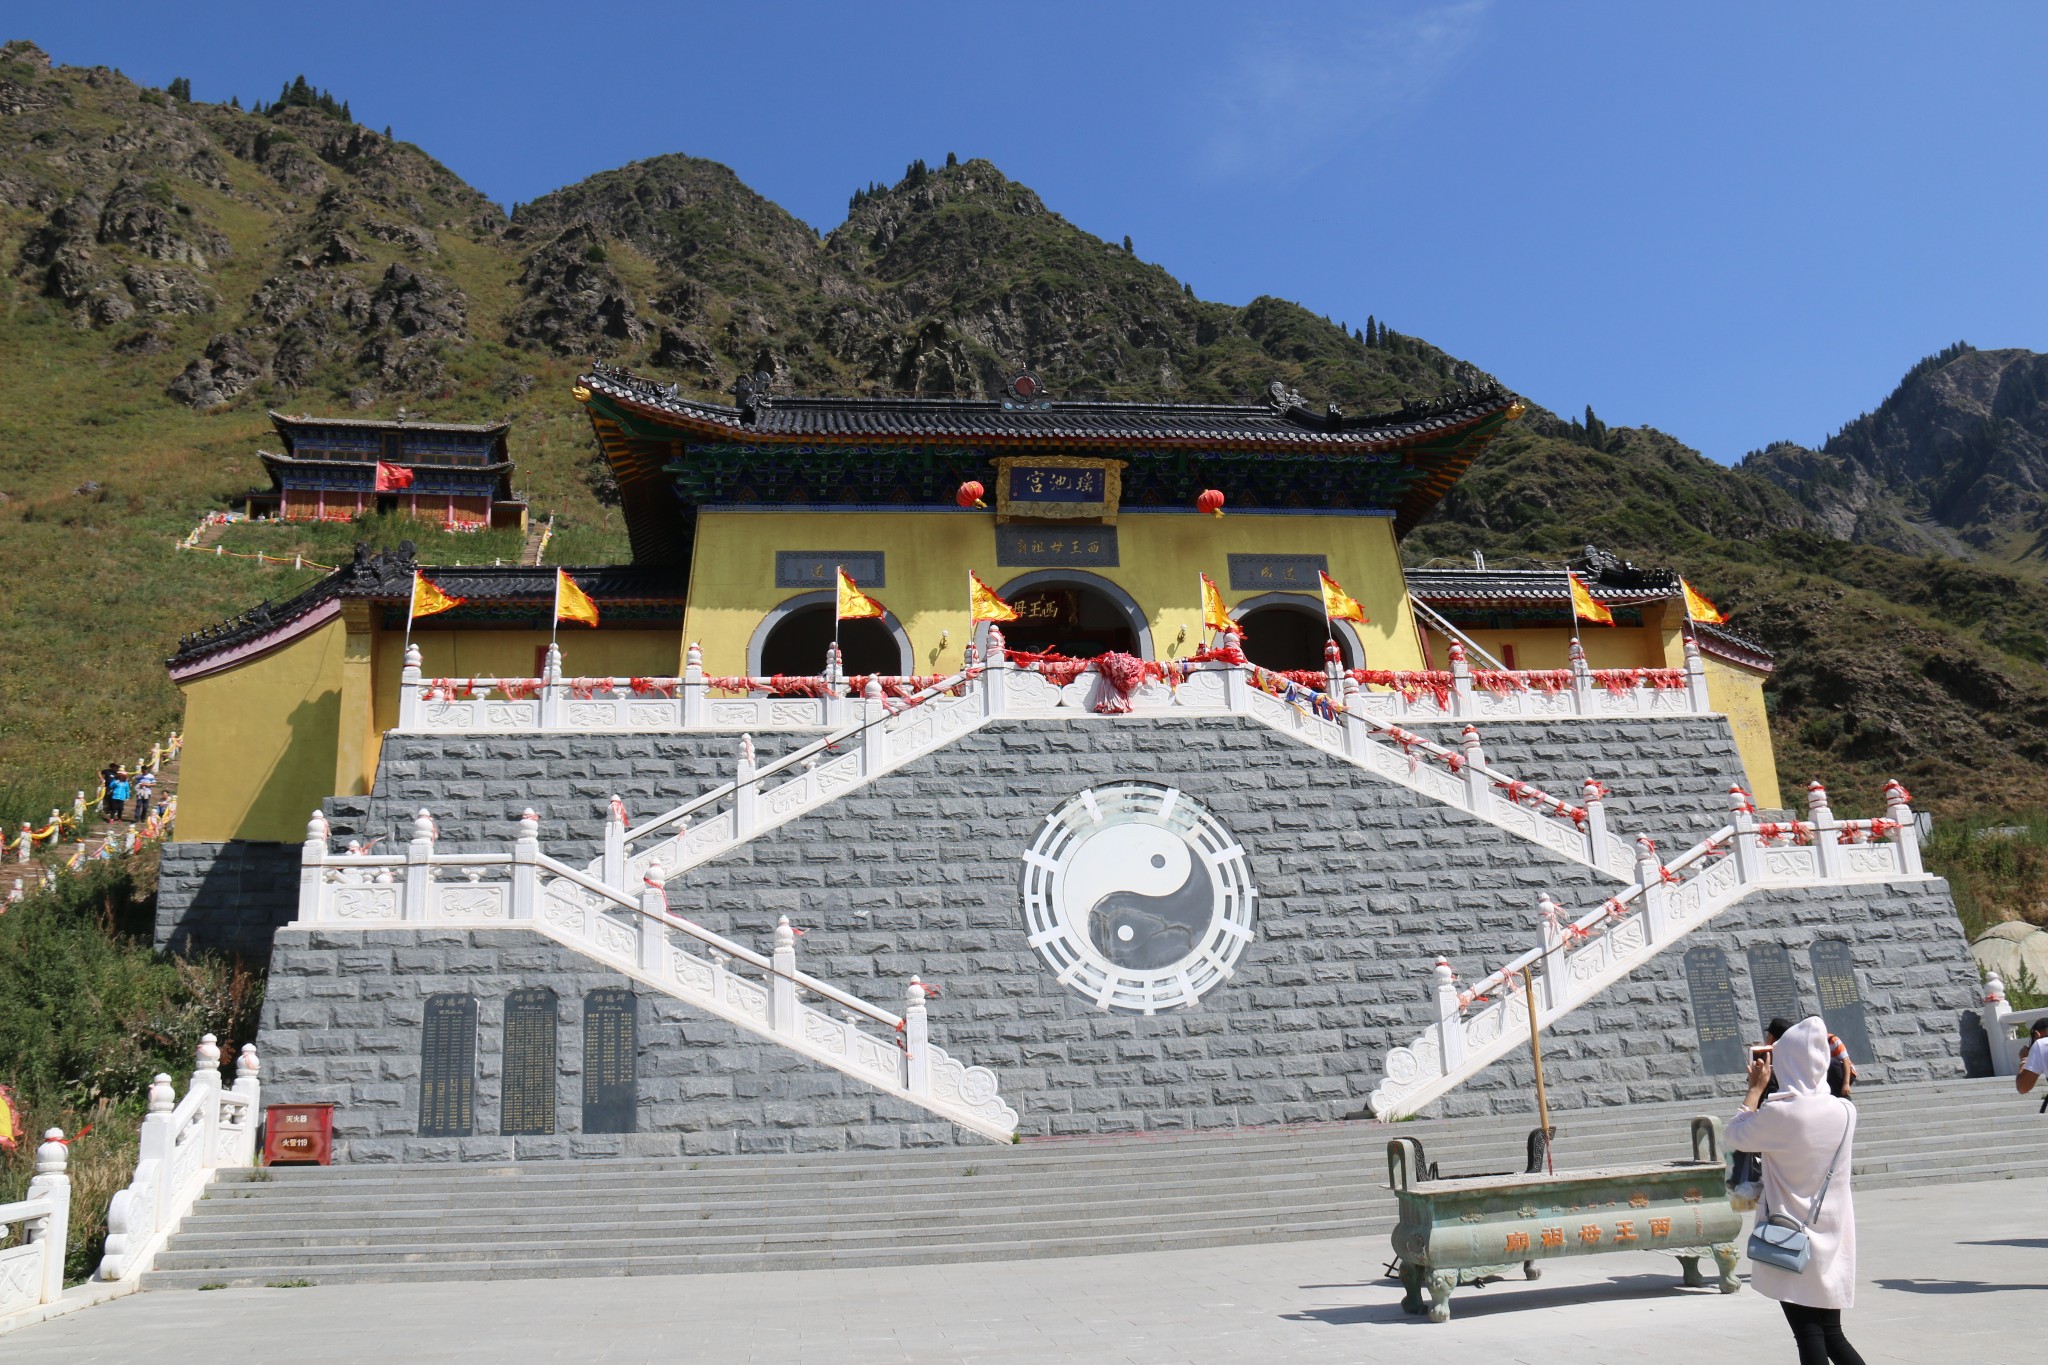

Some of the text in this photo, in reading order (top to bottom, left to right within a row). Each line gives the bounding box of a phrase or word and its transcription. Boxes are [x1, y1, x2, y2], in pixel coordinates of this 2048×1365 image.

[434, 997, 467, 1007] 功德碑
[514, 993, 546, 1003] 功德碑
[594, 993, 626, 1003] 功德碑
[285, 1114, 308, 1123] 灭火器
[282, 1138, 308, 1147] 火警119
[1504, 1216, 1672, 1251] 西王母祖廟
